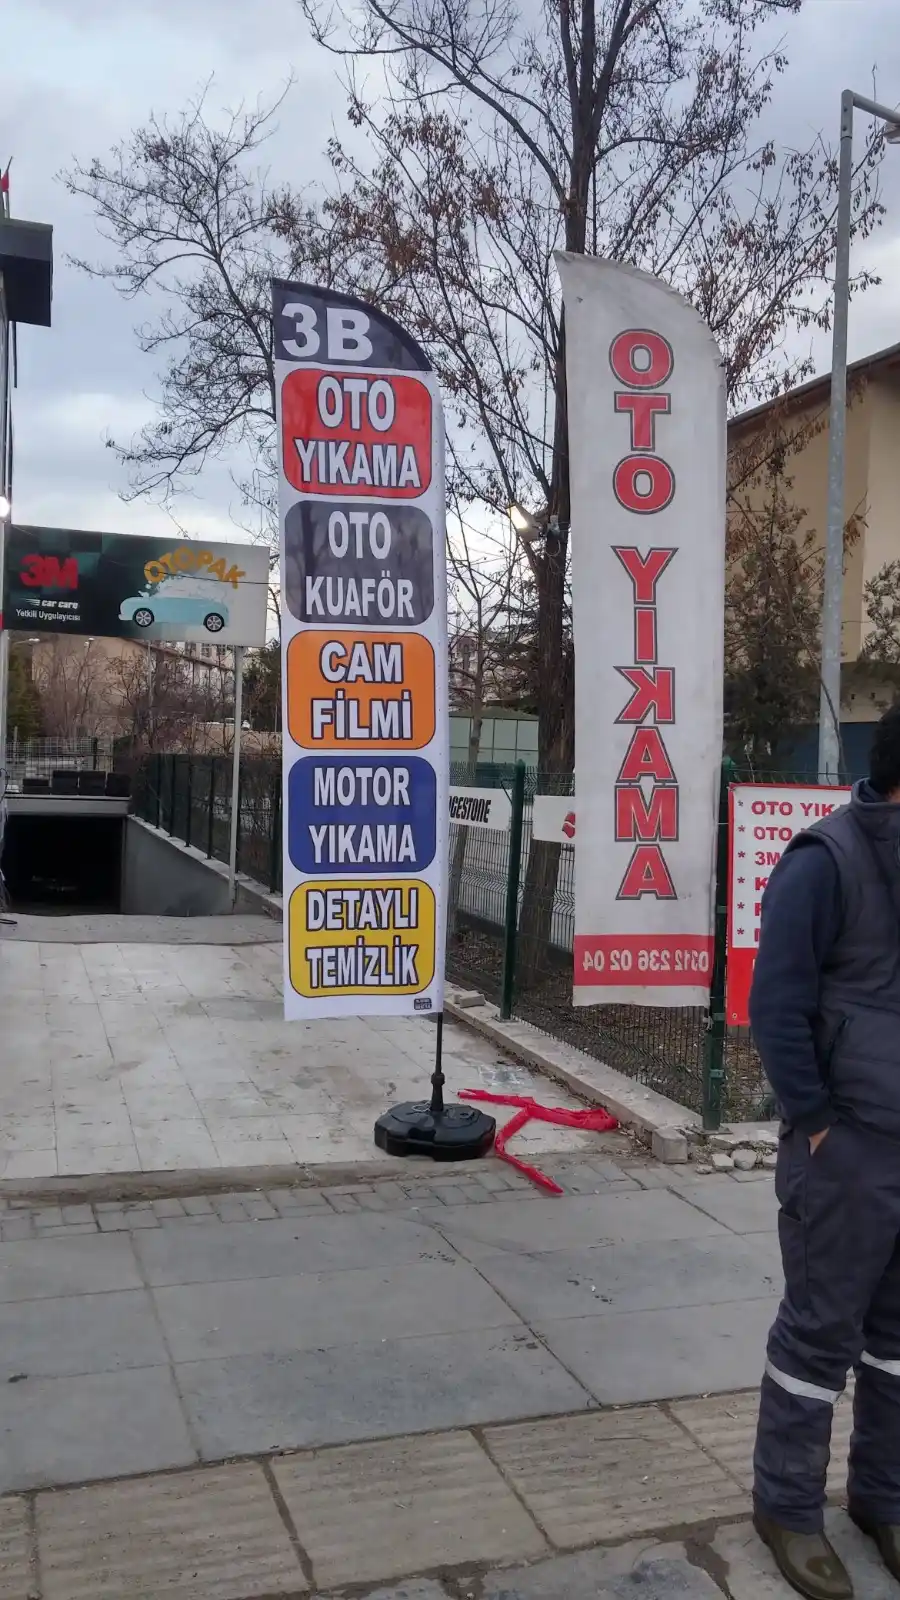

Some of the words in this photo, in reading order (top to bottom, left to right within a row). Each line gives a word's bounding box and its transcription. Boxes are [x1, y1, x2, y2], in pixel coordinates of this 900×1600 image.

[281, 302, 374, 362] 3B
[316, 375, 396, 432] OTO
[293, 438, 422, 489] YIKAMA
[327, 511, 392, 560] OTO
[19, 553, 79, 590] 3M
[144, 545, 246, 589] OTOPAK
[16, 609, 37, 618] Yetkili
[41, 600, 57, 608] car
[58, 601, 78, 609] care
[305, 570, 415, 619] KUAFÖR
[319, 640, 403, 684] CAM
[310, 688, 413, 740] FİLMİ
[313, 766, 410, 806] MOTOR
[751, 800, 793, 816] OTO
[800, 803, 836, 817] YIK
[308, 823, 417, 864] YIKAMA
[305, 887, 419, 932] DETAYLI
[305, 935, 419, 989] TEMİZLİK
